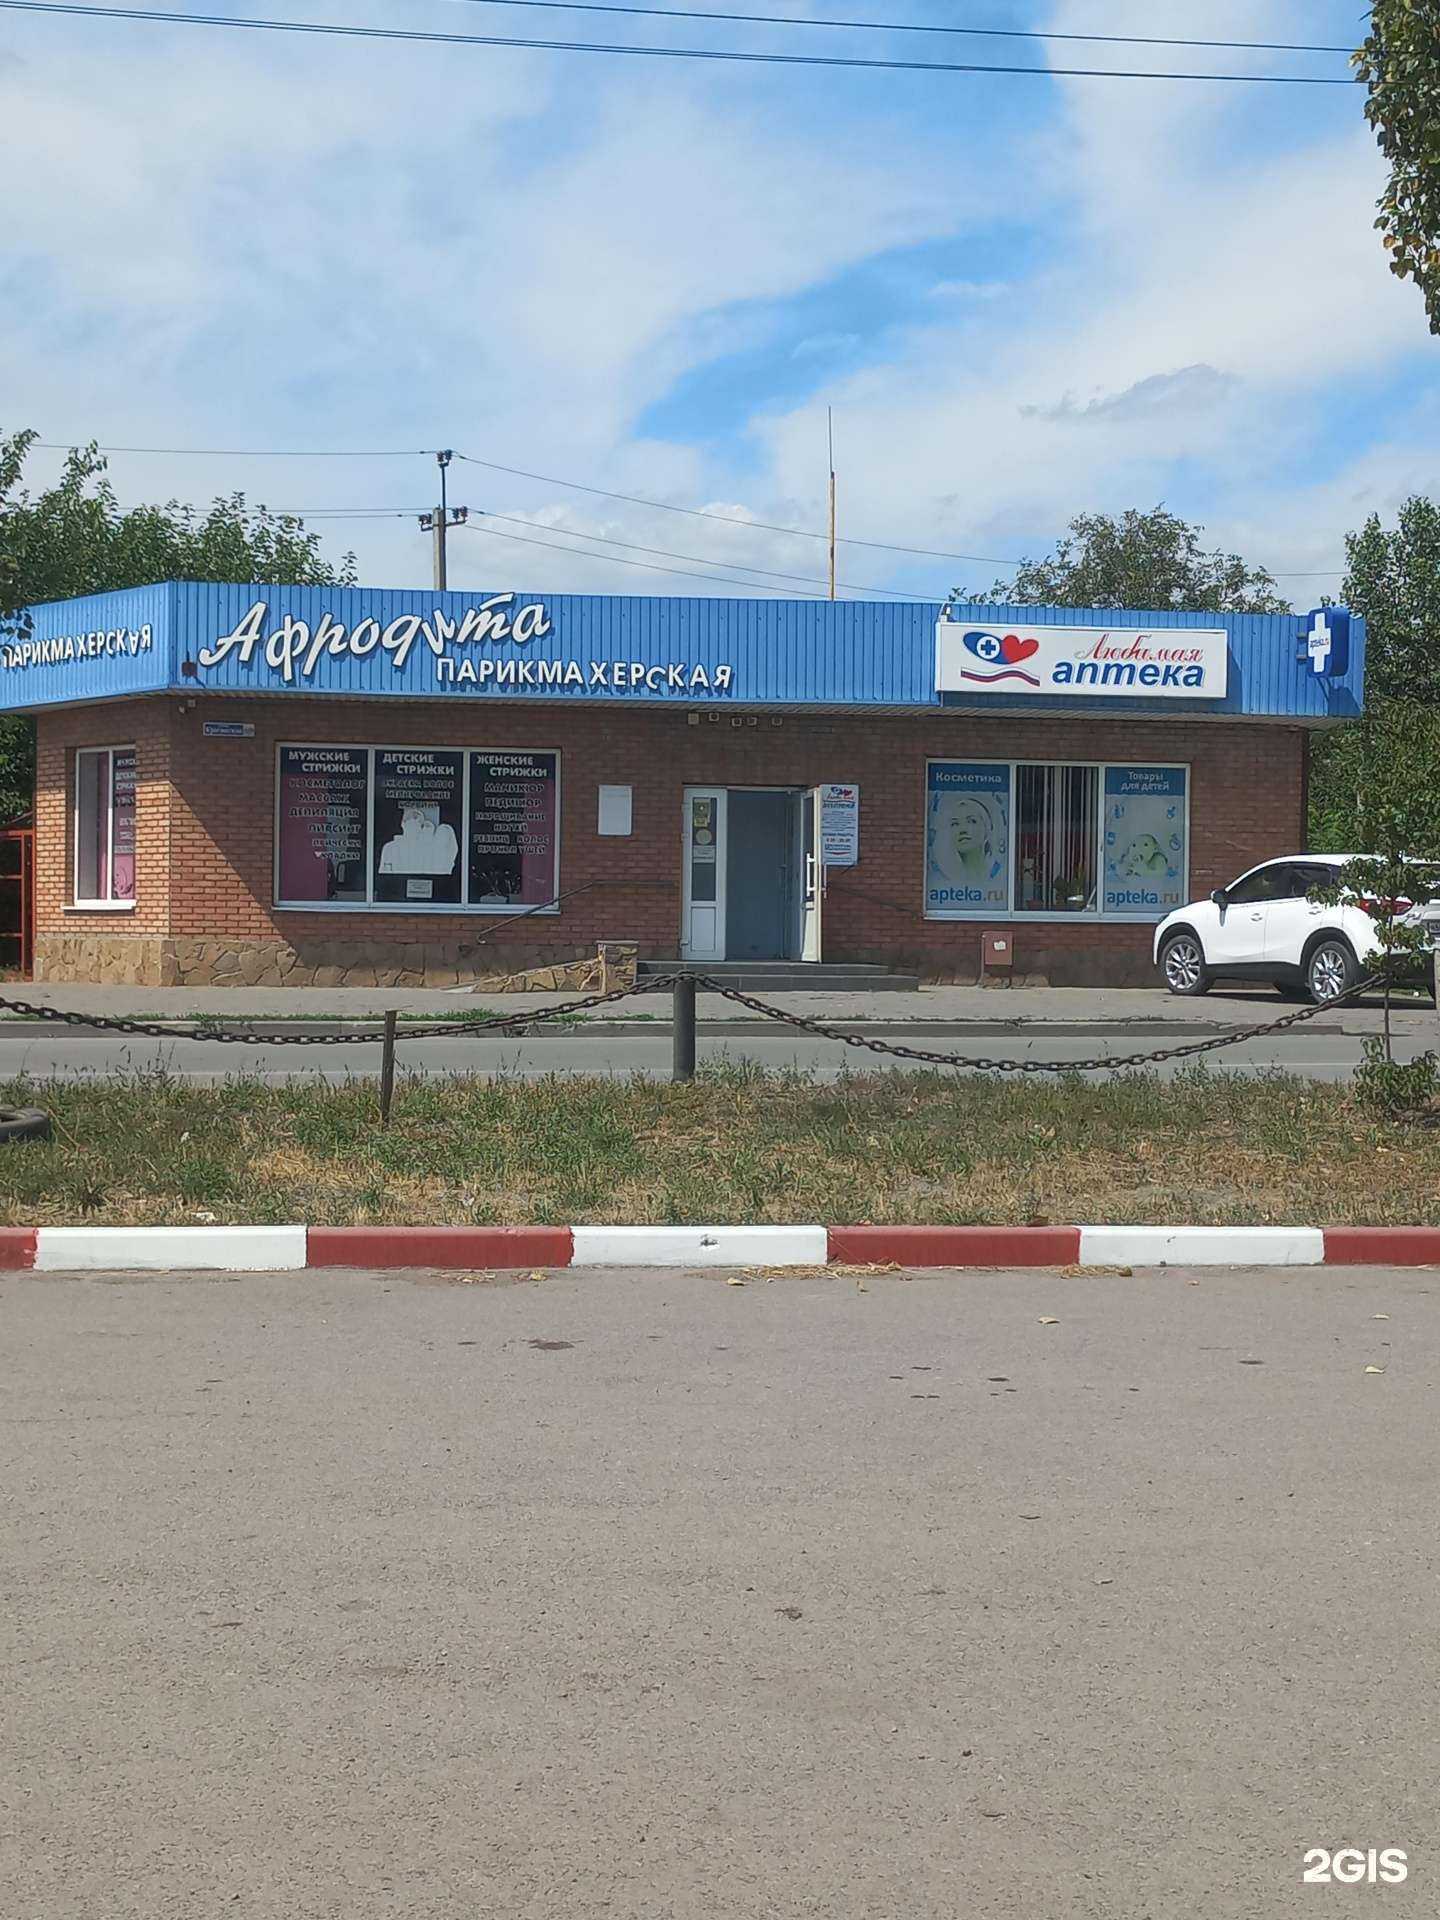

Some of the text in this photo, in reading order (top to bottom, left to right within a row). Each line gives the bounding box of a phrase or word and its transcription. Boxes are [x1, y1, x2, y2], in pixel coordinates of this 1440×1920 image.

[199, 592, 551, 682] Афродита
[1074, 632, 1204, 663] Любимая
[436, 657, 732, 689] ПАРИКМАХЕРСКАЯ
[1051, 660, 1205, 688] аптека
[288, 750, 350, 761] МУЖСКИЕ
[382, 753, 434, 764] ДЕТСКИЕ
[476, 755, 534, 766] ЖЕНСКИЕ
[302, 762, 361, 773] СТРИЖКИ
[396, 765, 455, 775] СТРИЖКИ
[489, 767, 548, 777] СТРИЖКИ
[935, 771, 1002, 783] Косметика
[1128, 770, 1163, 782] Товары
[484, 782, 545, 793] МАНИКЮР
[1140, 781, 1170, 792] детей
[929, 886, 1004, 904] apteka.ru
[1106, 888, 1179, 906] apteka.ru
